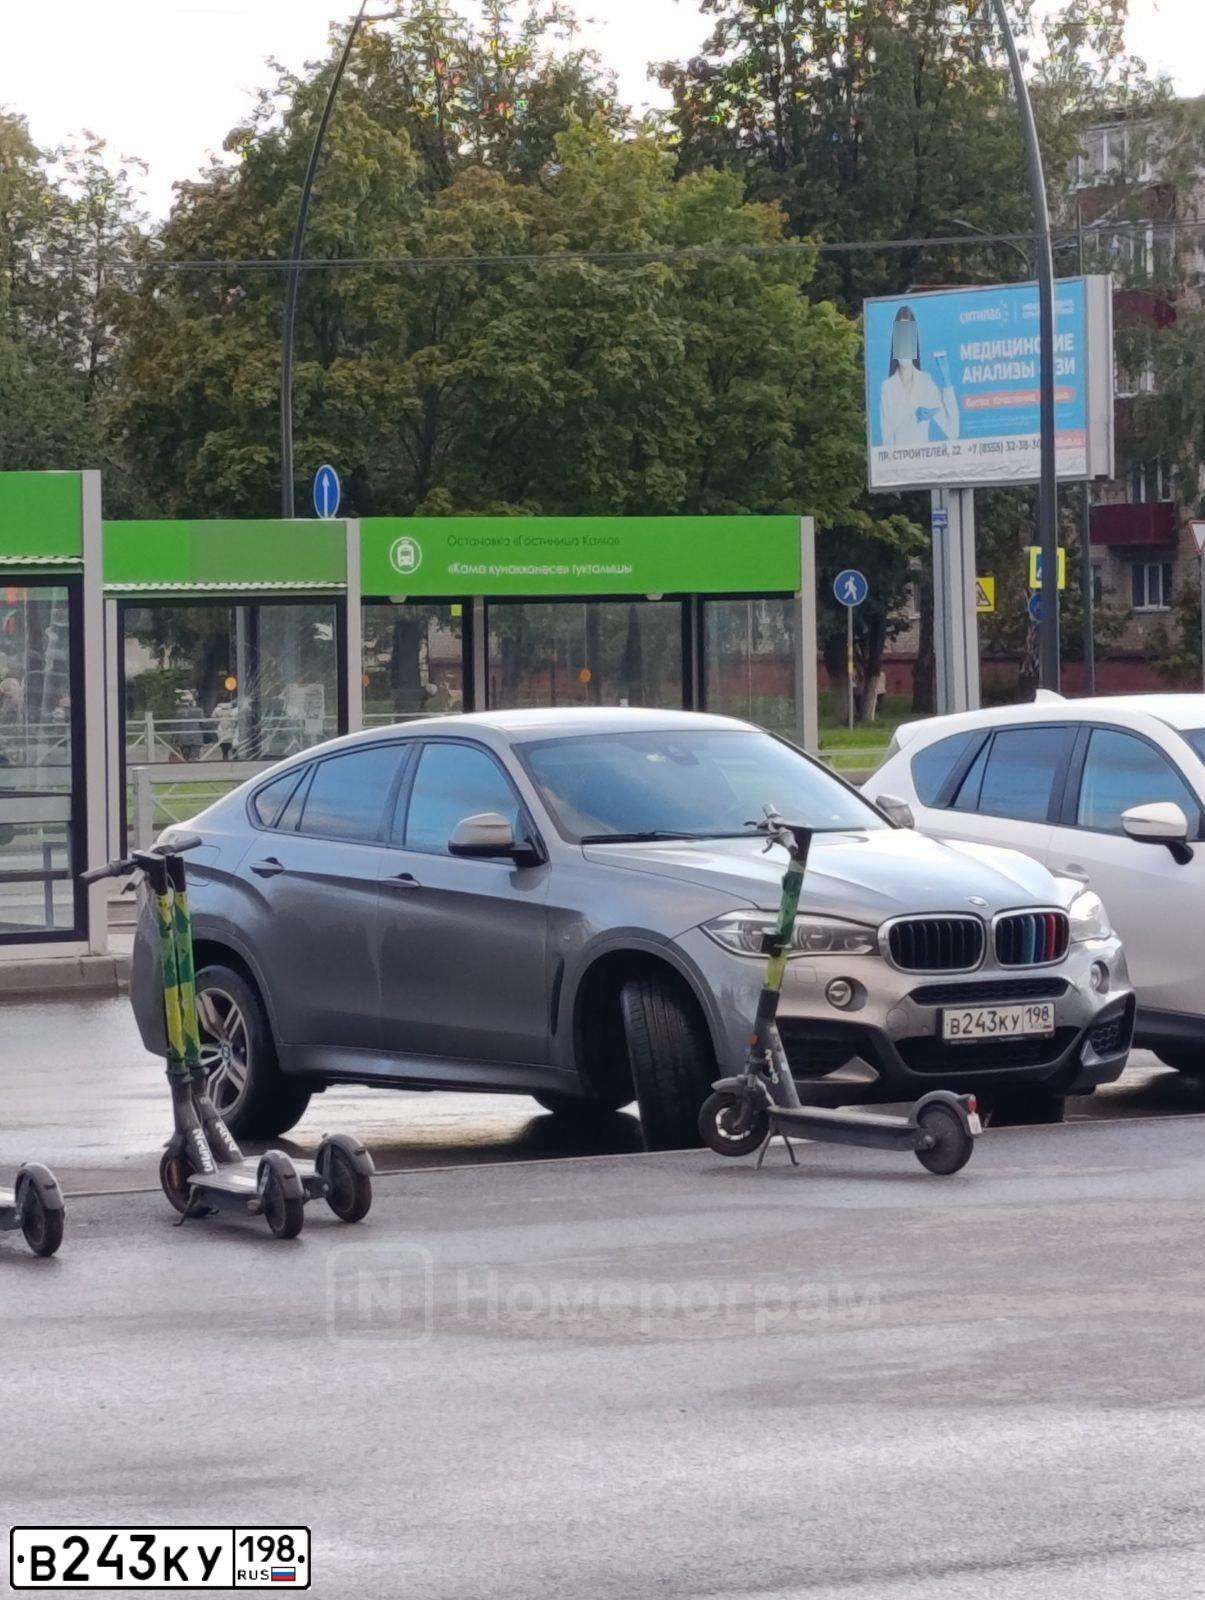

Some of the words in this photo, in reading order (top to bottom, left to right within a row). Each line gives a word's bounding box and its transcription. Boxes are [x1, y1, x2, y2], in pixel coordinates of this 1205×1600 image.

[960, 332, 1075, 361] МЕДИЦИНСИЕ
[963, 360, 1035, 384] АНАЛИЗЫ
[1055, 357, 1076, 377] ЗИ
[447, 534, 510, 547] Остановка
[950, 1010, 1020, 1035] В243КУ
[1025, 1006, 1049, 1023] 198
